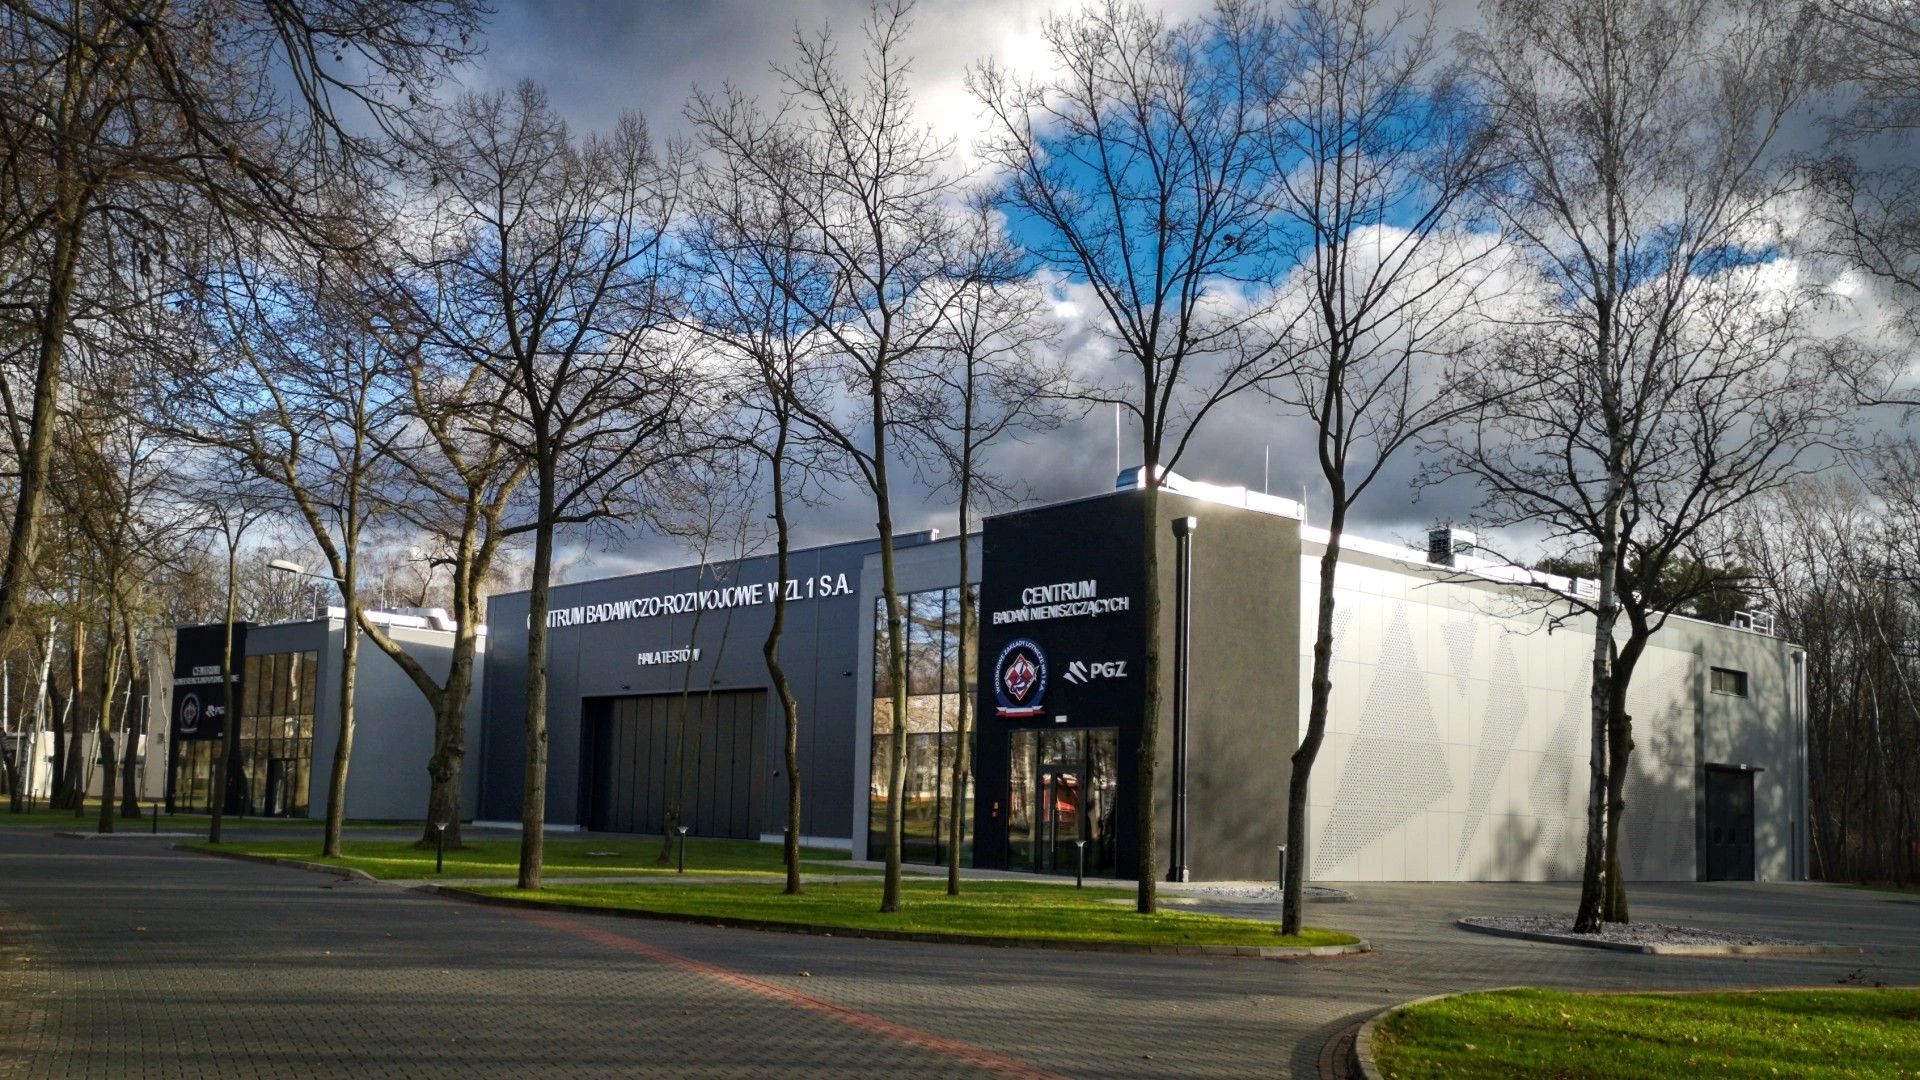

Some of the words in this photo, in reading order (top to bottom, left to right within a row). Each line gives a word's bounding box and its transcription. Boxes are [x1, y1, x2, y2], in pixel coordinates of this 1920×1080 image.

[527, 607, 585, 630] NTRUM
[586, 583, 763, 624] BADAWCZO-ROZWOJOWE
[768, 579, 803, 603] WZL
[806, 577, 814, 598] 1
[820, 573, 853, 597] S.A.
[1022, 579, 1097, 605] CENTRUM
[993, 606, 1029, 624] BADAŃ
[1030, 597, 1129, 620] NIENISZCZĄCYCH
[638, 651, 661, 665] HALA
[1091, 661, 1128, 678] PGZ
